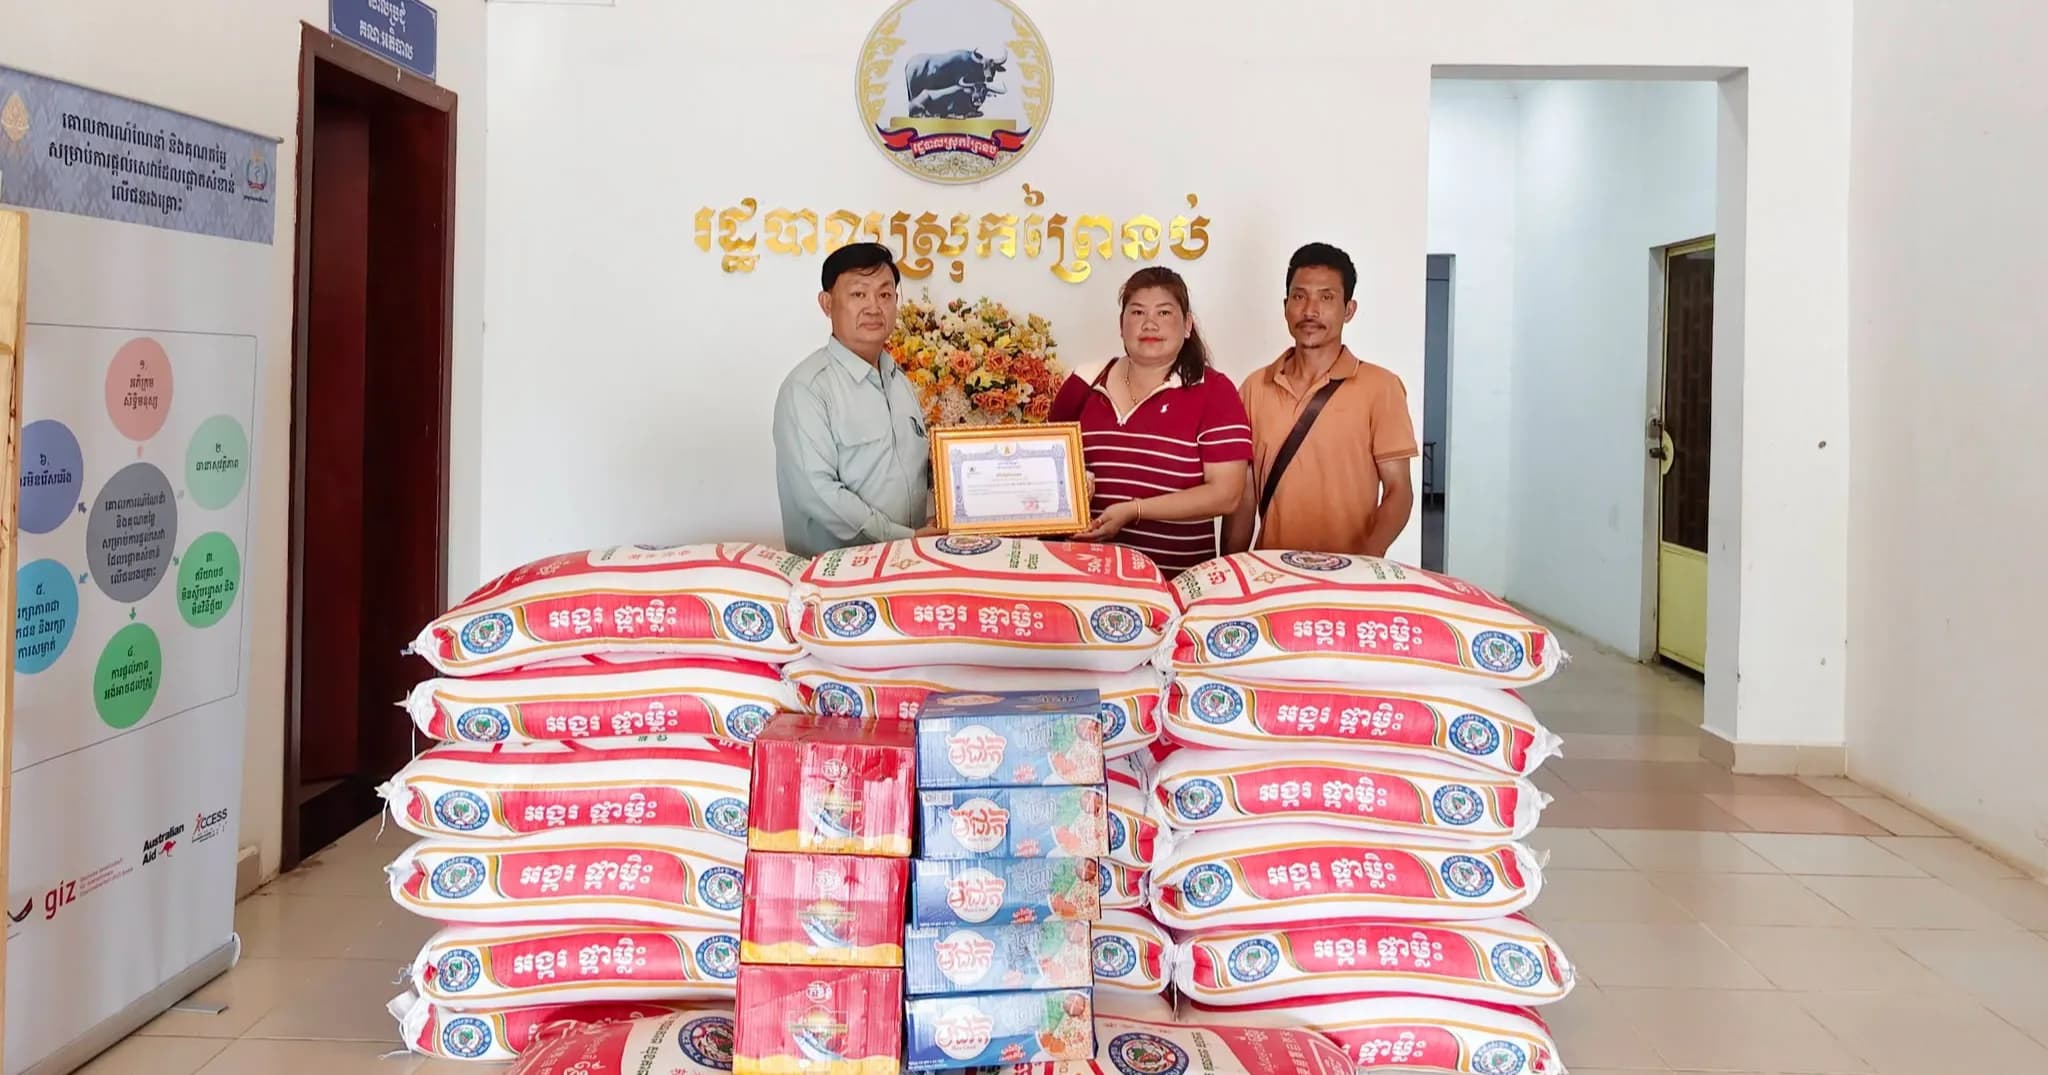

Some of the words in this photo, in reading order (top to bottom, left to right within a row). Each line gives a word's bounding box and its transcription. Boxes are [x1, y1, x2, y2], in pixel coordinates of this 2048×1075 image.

[548, 607, 604, 635] អង្ករ
[613, 598, 679, 634] ផ្កាម្លិះ
[913, 604, 968, 631] អង្ករ
[977, 603, 1044, 637] ផ្កាម្លិះ
[1293, 618, 1346, 645] អង្ករ
[1356, 616, 1424, 650] ផ្កាម្លិះ
[545, 713, 602, 738] អង្ករ
[610, 702, 679, 736] ផ្កាម្លិះ
[1277, 703, 1331, 731] អង្ករ
[1339, 703, 1405, 736] ផ្កាម្លិះ
[524, 804, 579, 827] អង្ករ
[589, 793, 658, 826] ផ្កាម្លិះ
[1258, 781, 1312, 808] អង្ករ
[1322, 776, 1388, 812] ផ្កាម្លិះ
[142, 823, 185, 853] Australian
[142, 850, 157, 866] Aid
[519, 862, 576, 891] អង្ករ
[584, 854, 655, 892] ផ្កាម្លិះ
[1267, 860, 1322, 891] អង្ករ
[1330, 852, 1397, 888] ផ្កាម្លិះ
[45, 880, 77, 920] giz
[513, 949, 570, 979] អង្ករ
[578, 938, 649, 976] ផ្កាម្លិះ
[1313, 939, 1368, 967] អង្ករ
[1377, 931, 1443, 968] ផ្កាម្លិះ
